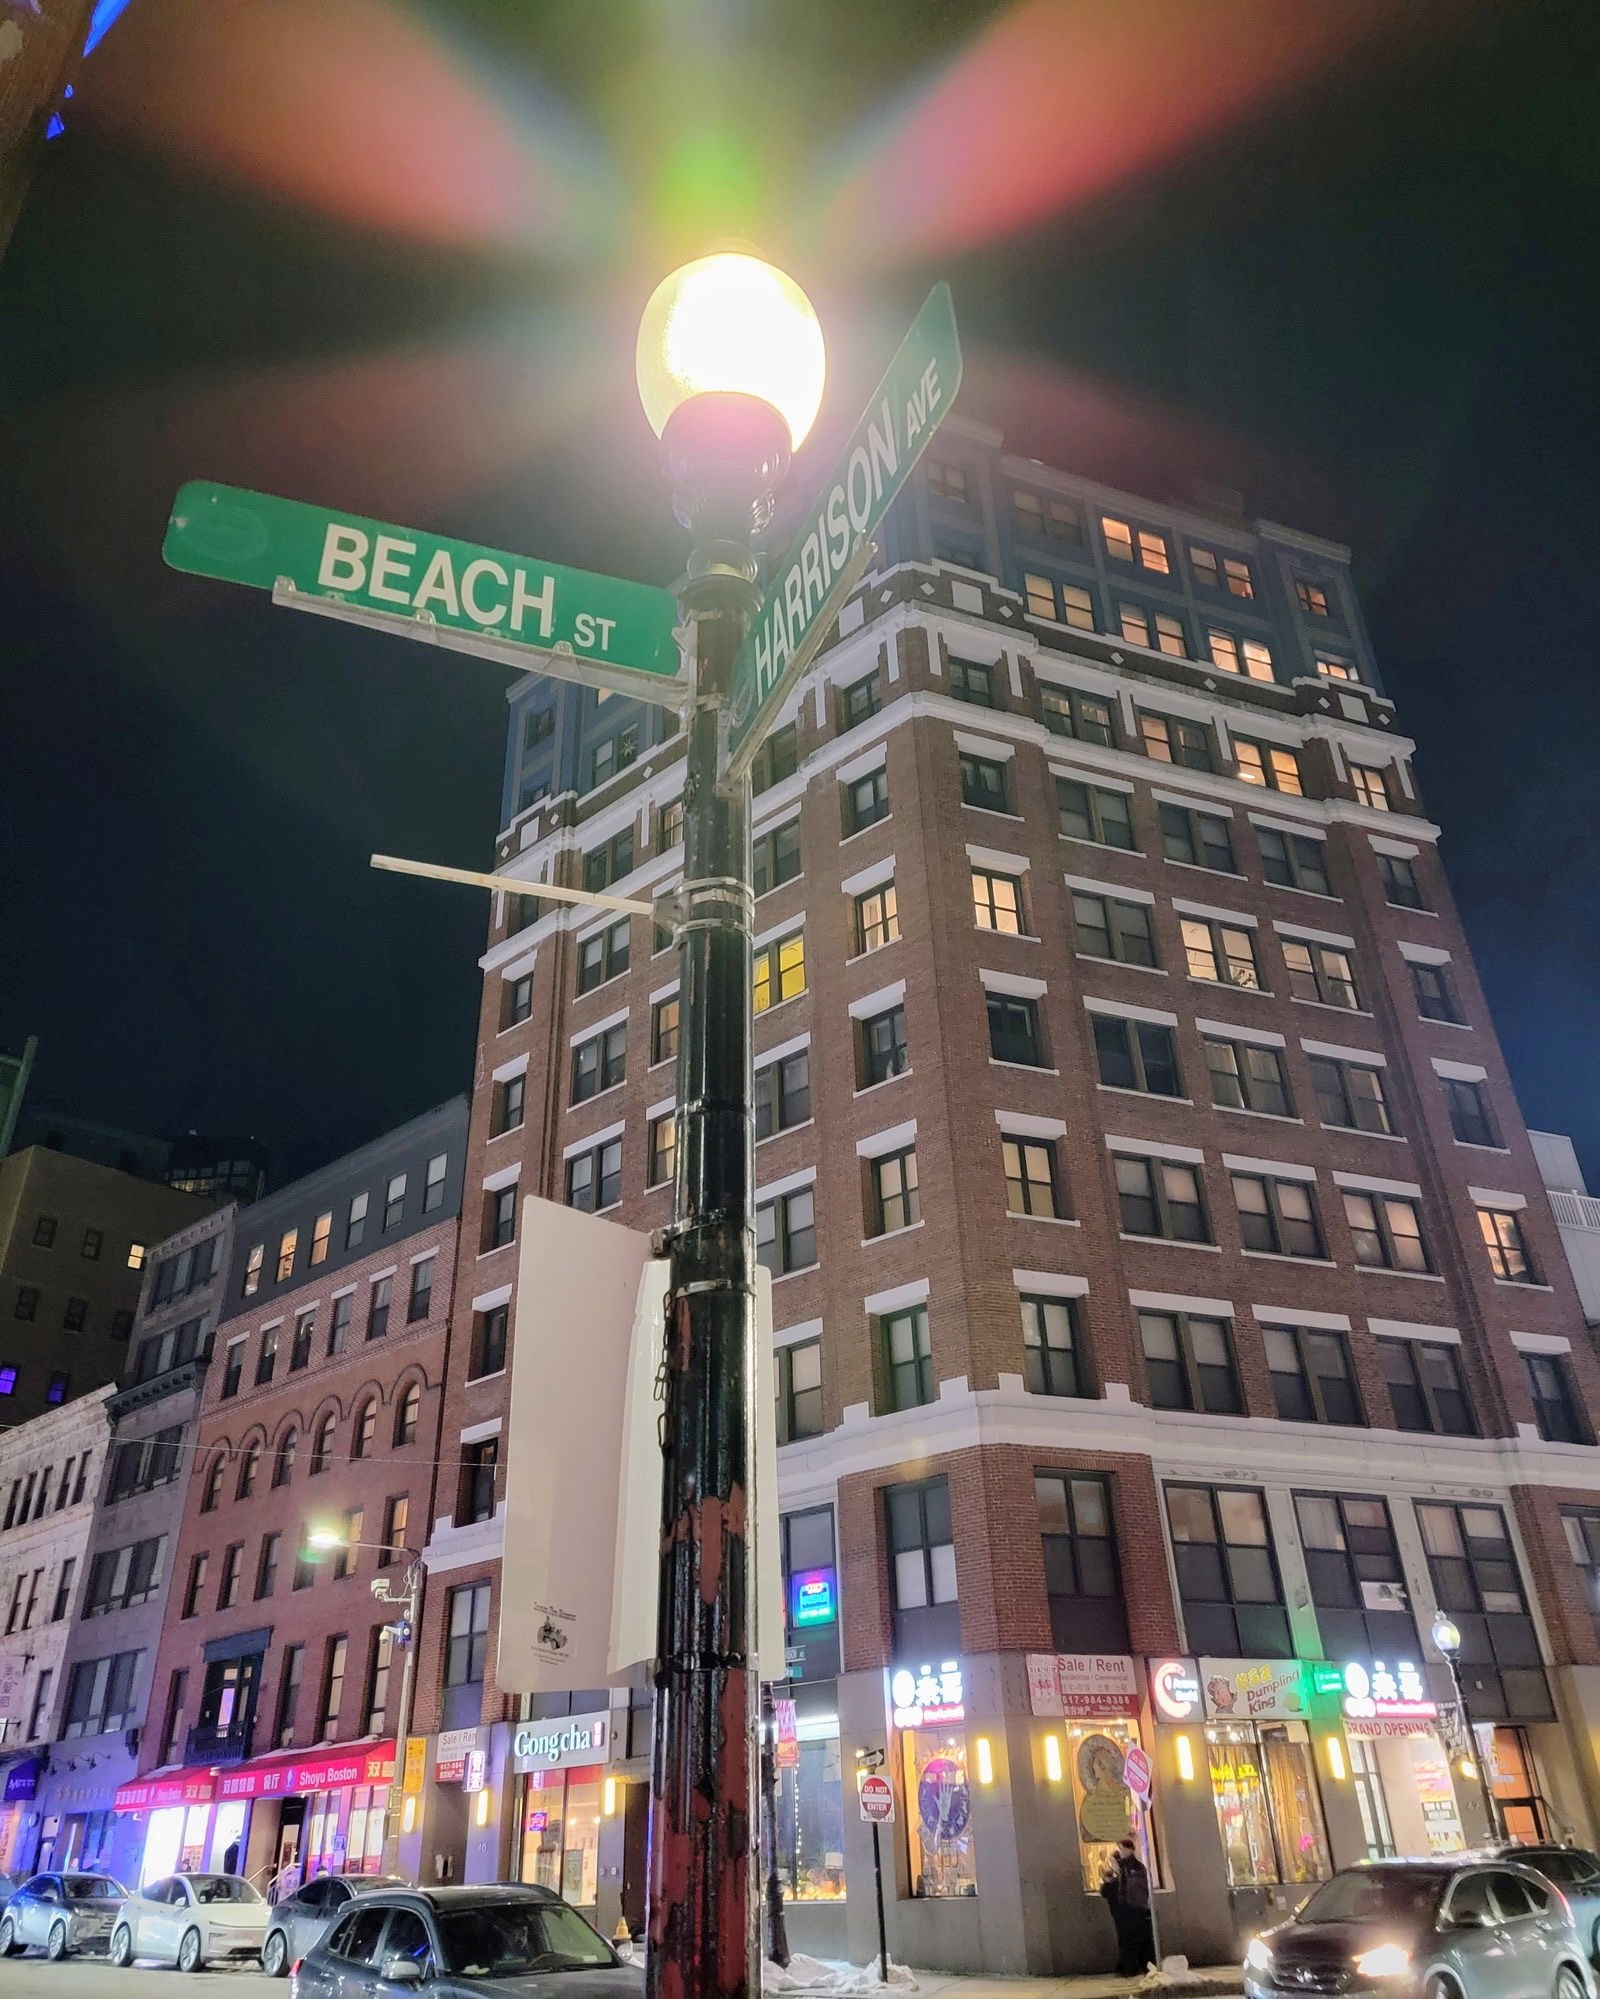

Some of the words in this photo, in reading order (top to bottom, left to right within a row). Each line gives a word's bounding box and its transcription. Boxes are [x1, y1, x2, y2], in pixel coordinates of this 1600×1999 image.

[754, 396, 900, 707] HARRISON
[907, 357, 942, 450] AVE
[316, 522, 556, 640] BEACH
[573, 612, 617, 653] ST
[1058, 1657, 1085, 1671] Sale
[1096, 1658, 1126, 1673] Rent
[1249, 1695, 1276, 1715] King
[1383, 1722, 1430, 1737] OPENING
[299, 1770, 326, 1788] Shoyu
[327, 1767, 358, 1784] Boston
[864, 1785, 874, 1793] DO
[875, 1786, 888, 1794] NOT
[867, 1802, 888, 1812] ENTER
